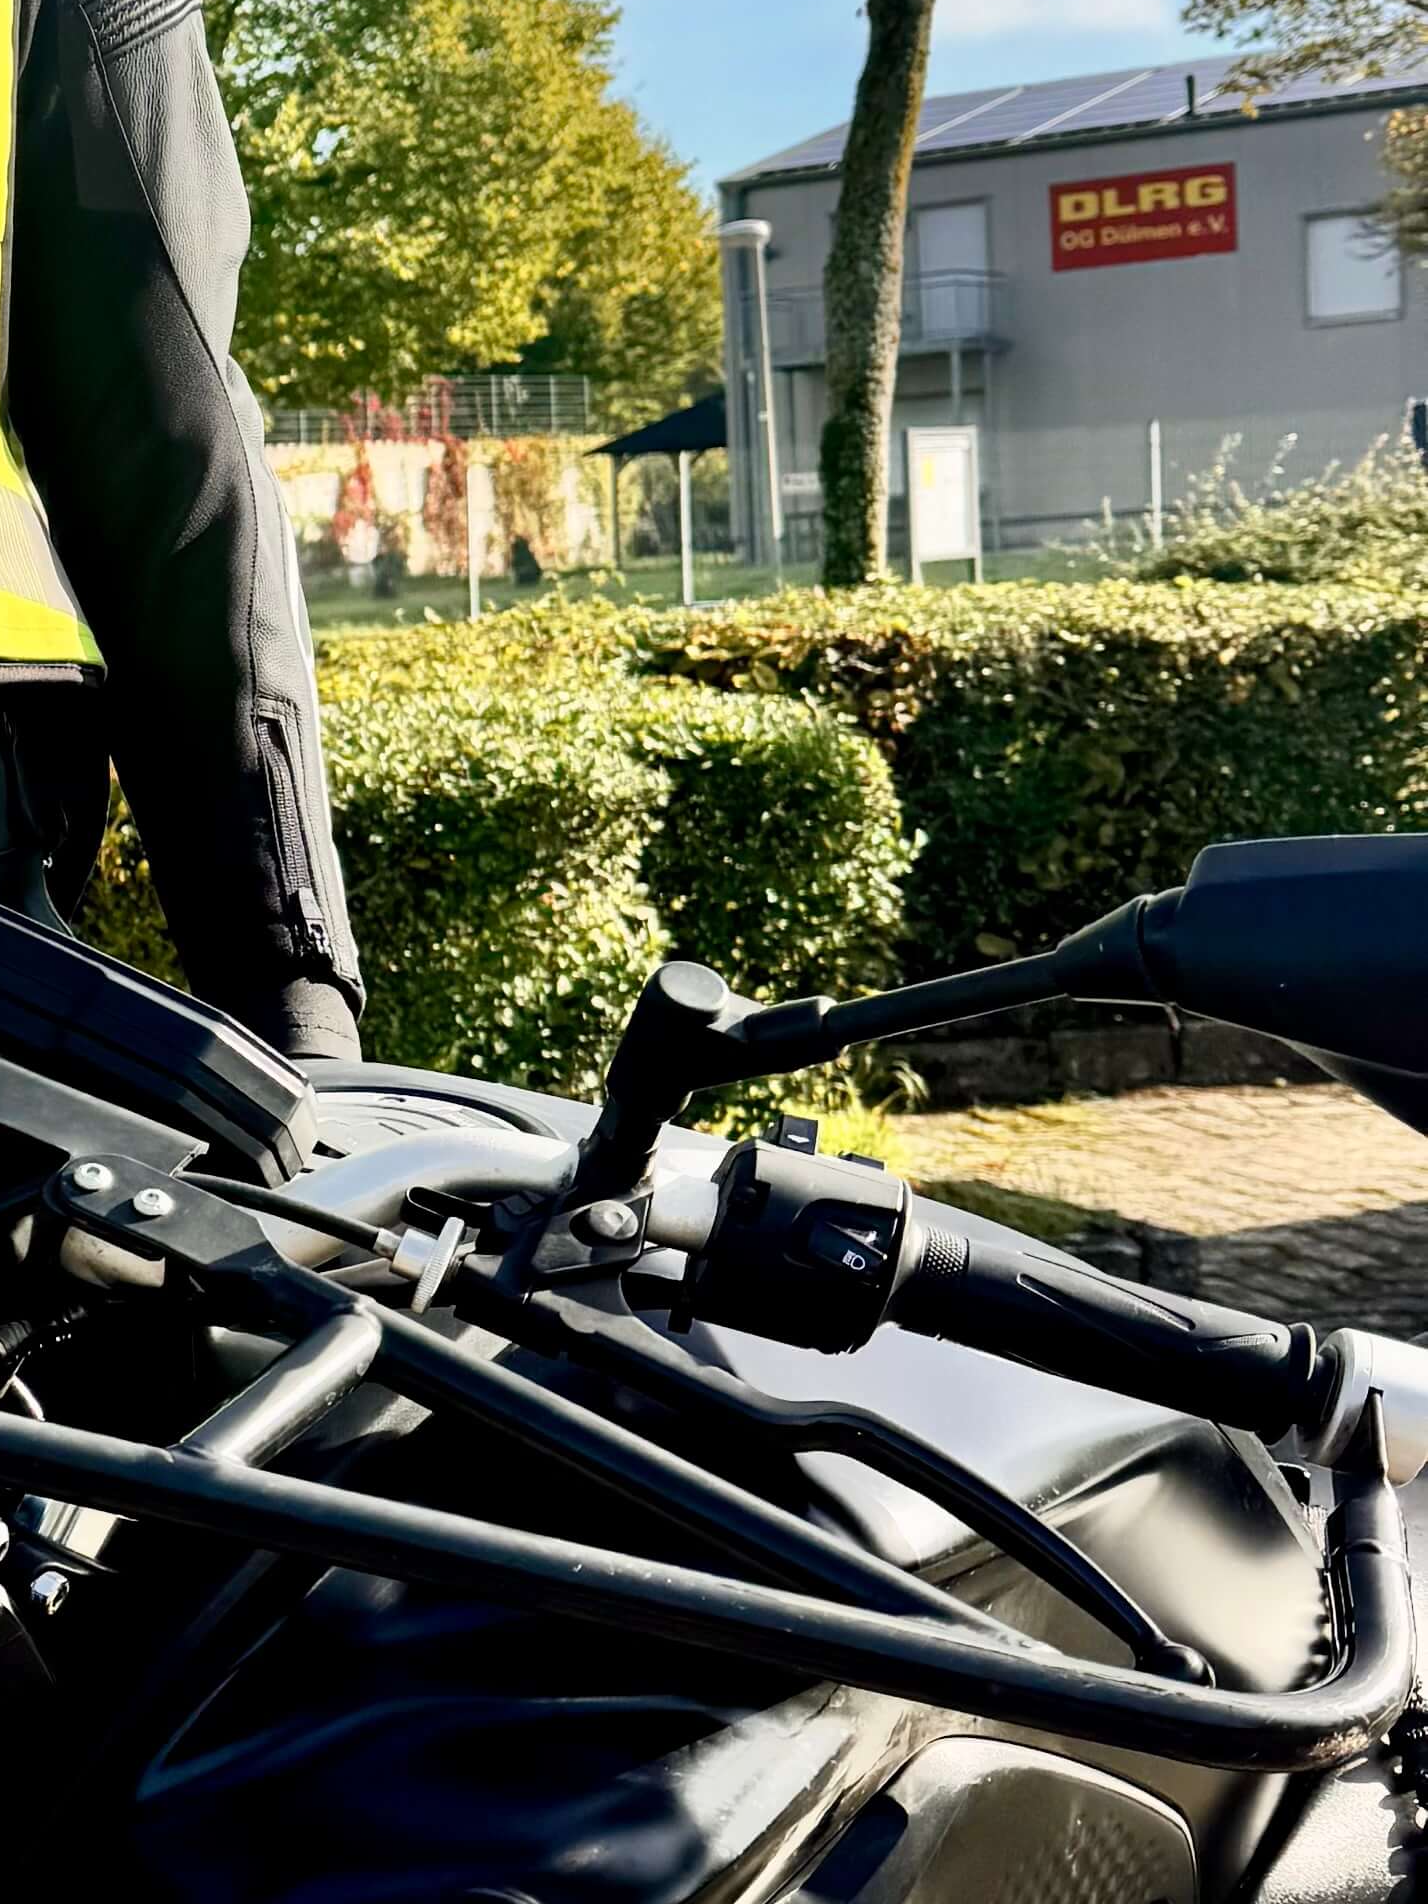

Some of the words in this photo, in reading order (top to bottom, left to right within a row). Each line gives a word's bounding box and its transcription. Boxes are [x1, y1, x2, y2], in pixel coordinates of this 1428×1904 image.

[1058, 175, 1228, 223] DLRG
[1060, 228, 1096, 251] OG
[1100, 222, 1183, 247] Dülmen
